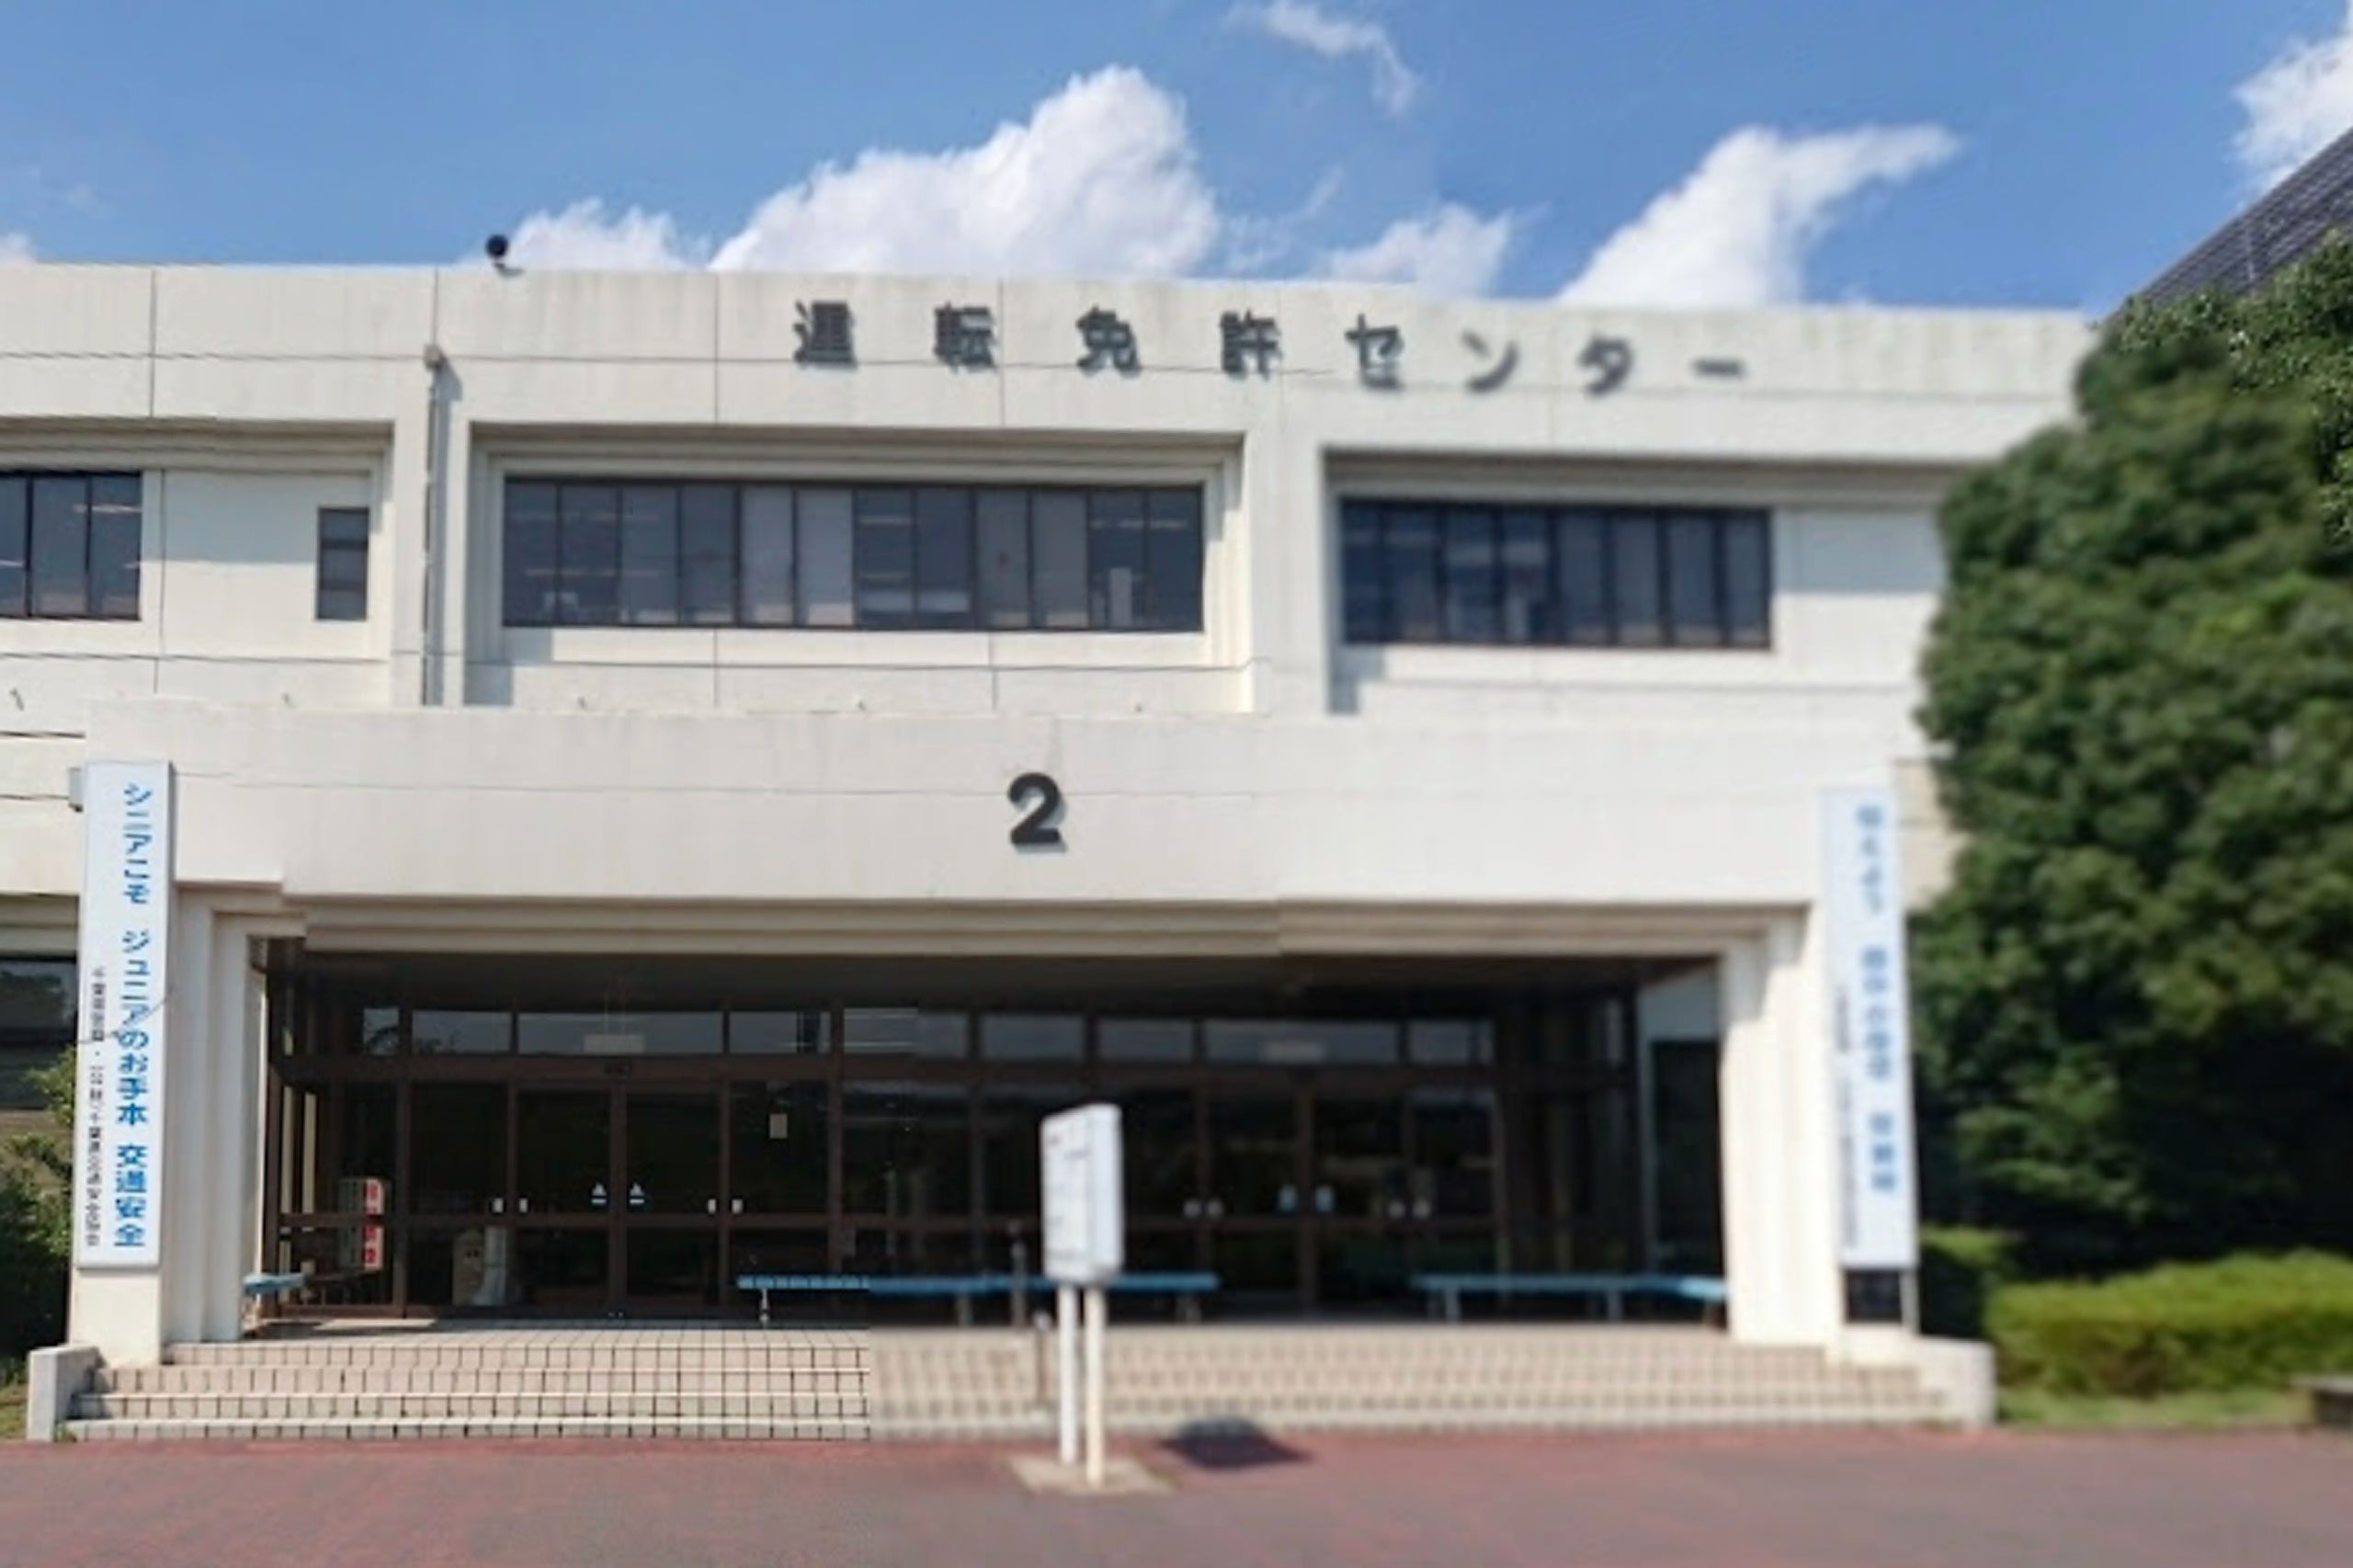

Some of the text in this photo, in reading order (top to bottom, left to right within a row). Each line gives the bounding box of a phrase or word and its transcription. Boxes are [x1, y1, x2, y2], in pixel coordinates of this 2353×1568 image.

[793, 301, 1745, 395] 運転免許センター
[1007, 772, 1061, 846] 2
[114, 783, 152, 1247] シニアこそ ジュニアのお手本 交通安全
